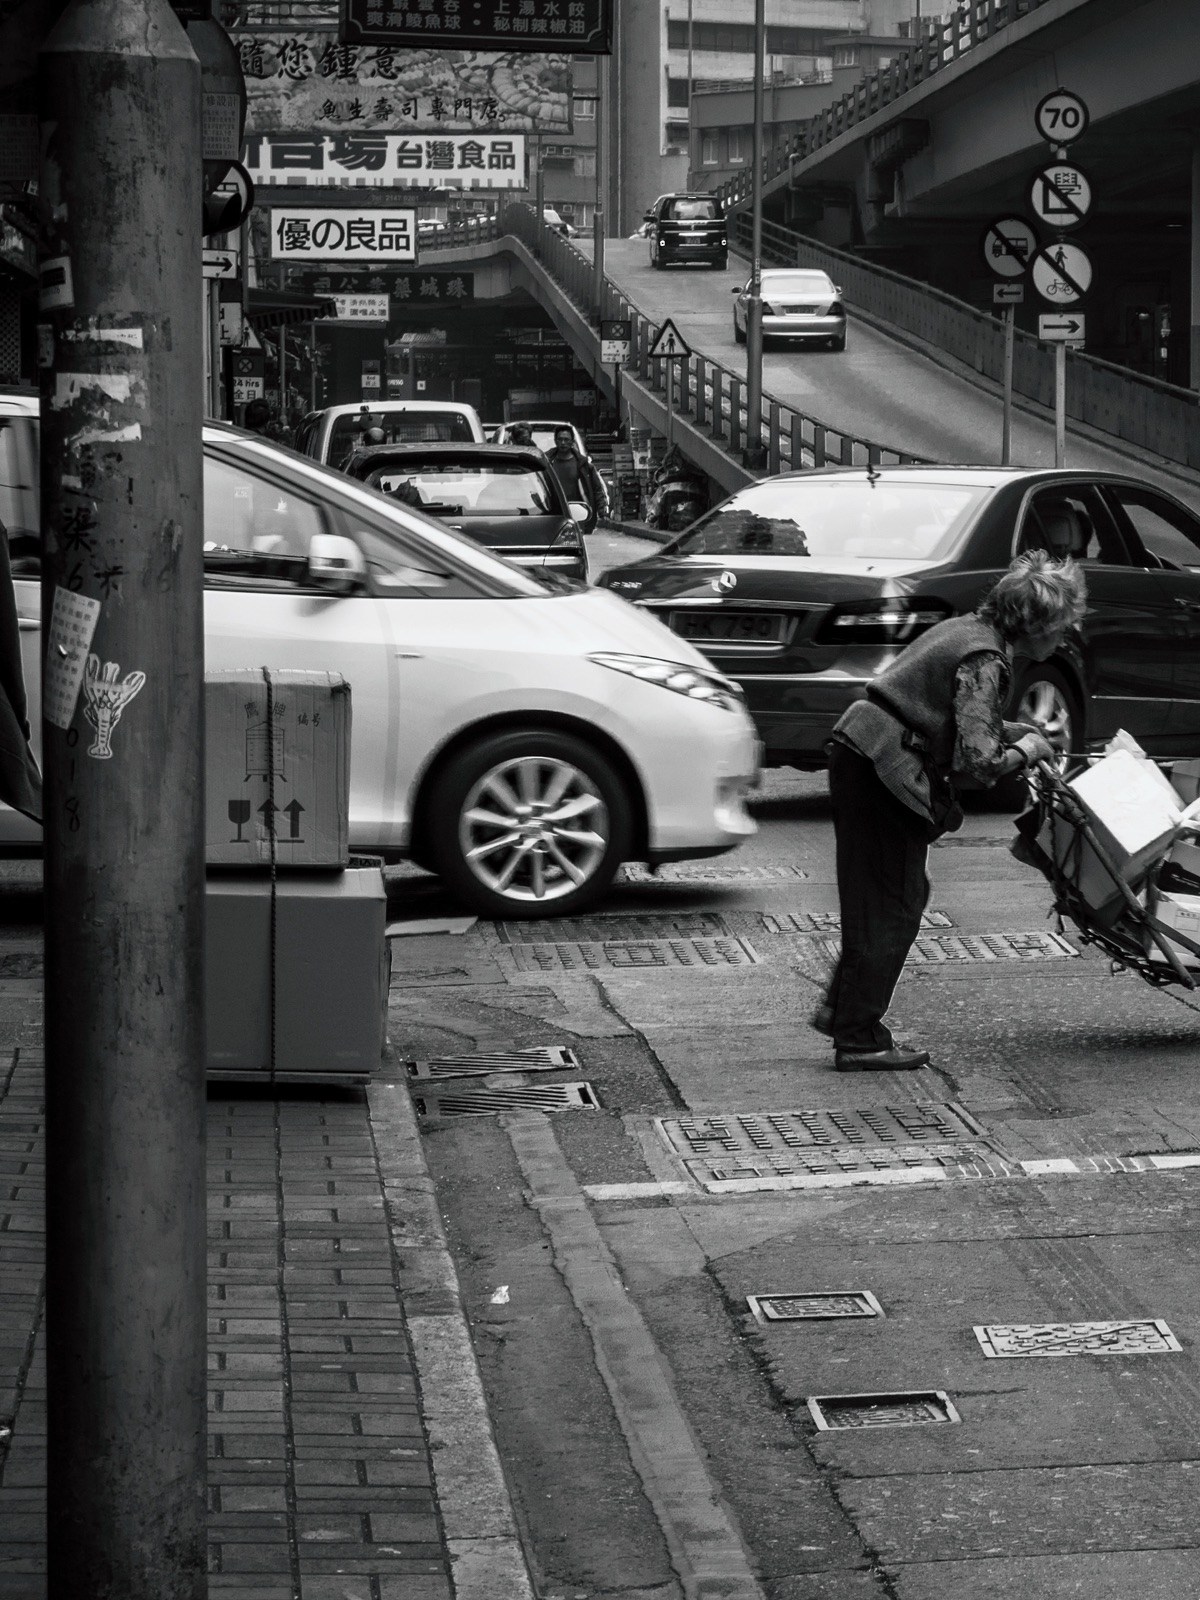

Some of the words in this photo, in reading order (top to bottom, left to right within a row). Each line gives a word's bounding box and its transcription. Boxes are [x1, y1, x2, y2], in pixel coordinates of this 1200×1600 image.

[366, 11, 461, 30] 爽滑鯪魚球
[493, 16, 585, 35] 秘制辣椒油
[318, 97, 499, 121] 魚生壽司專門店
[1044, 107, 1080, 129] 70
[395, 140, 514, 170] 台灣食品
[277, 217, 411, 252] 優の良品
[245, 379, 260, 387] hrs
